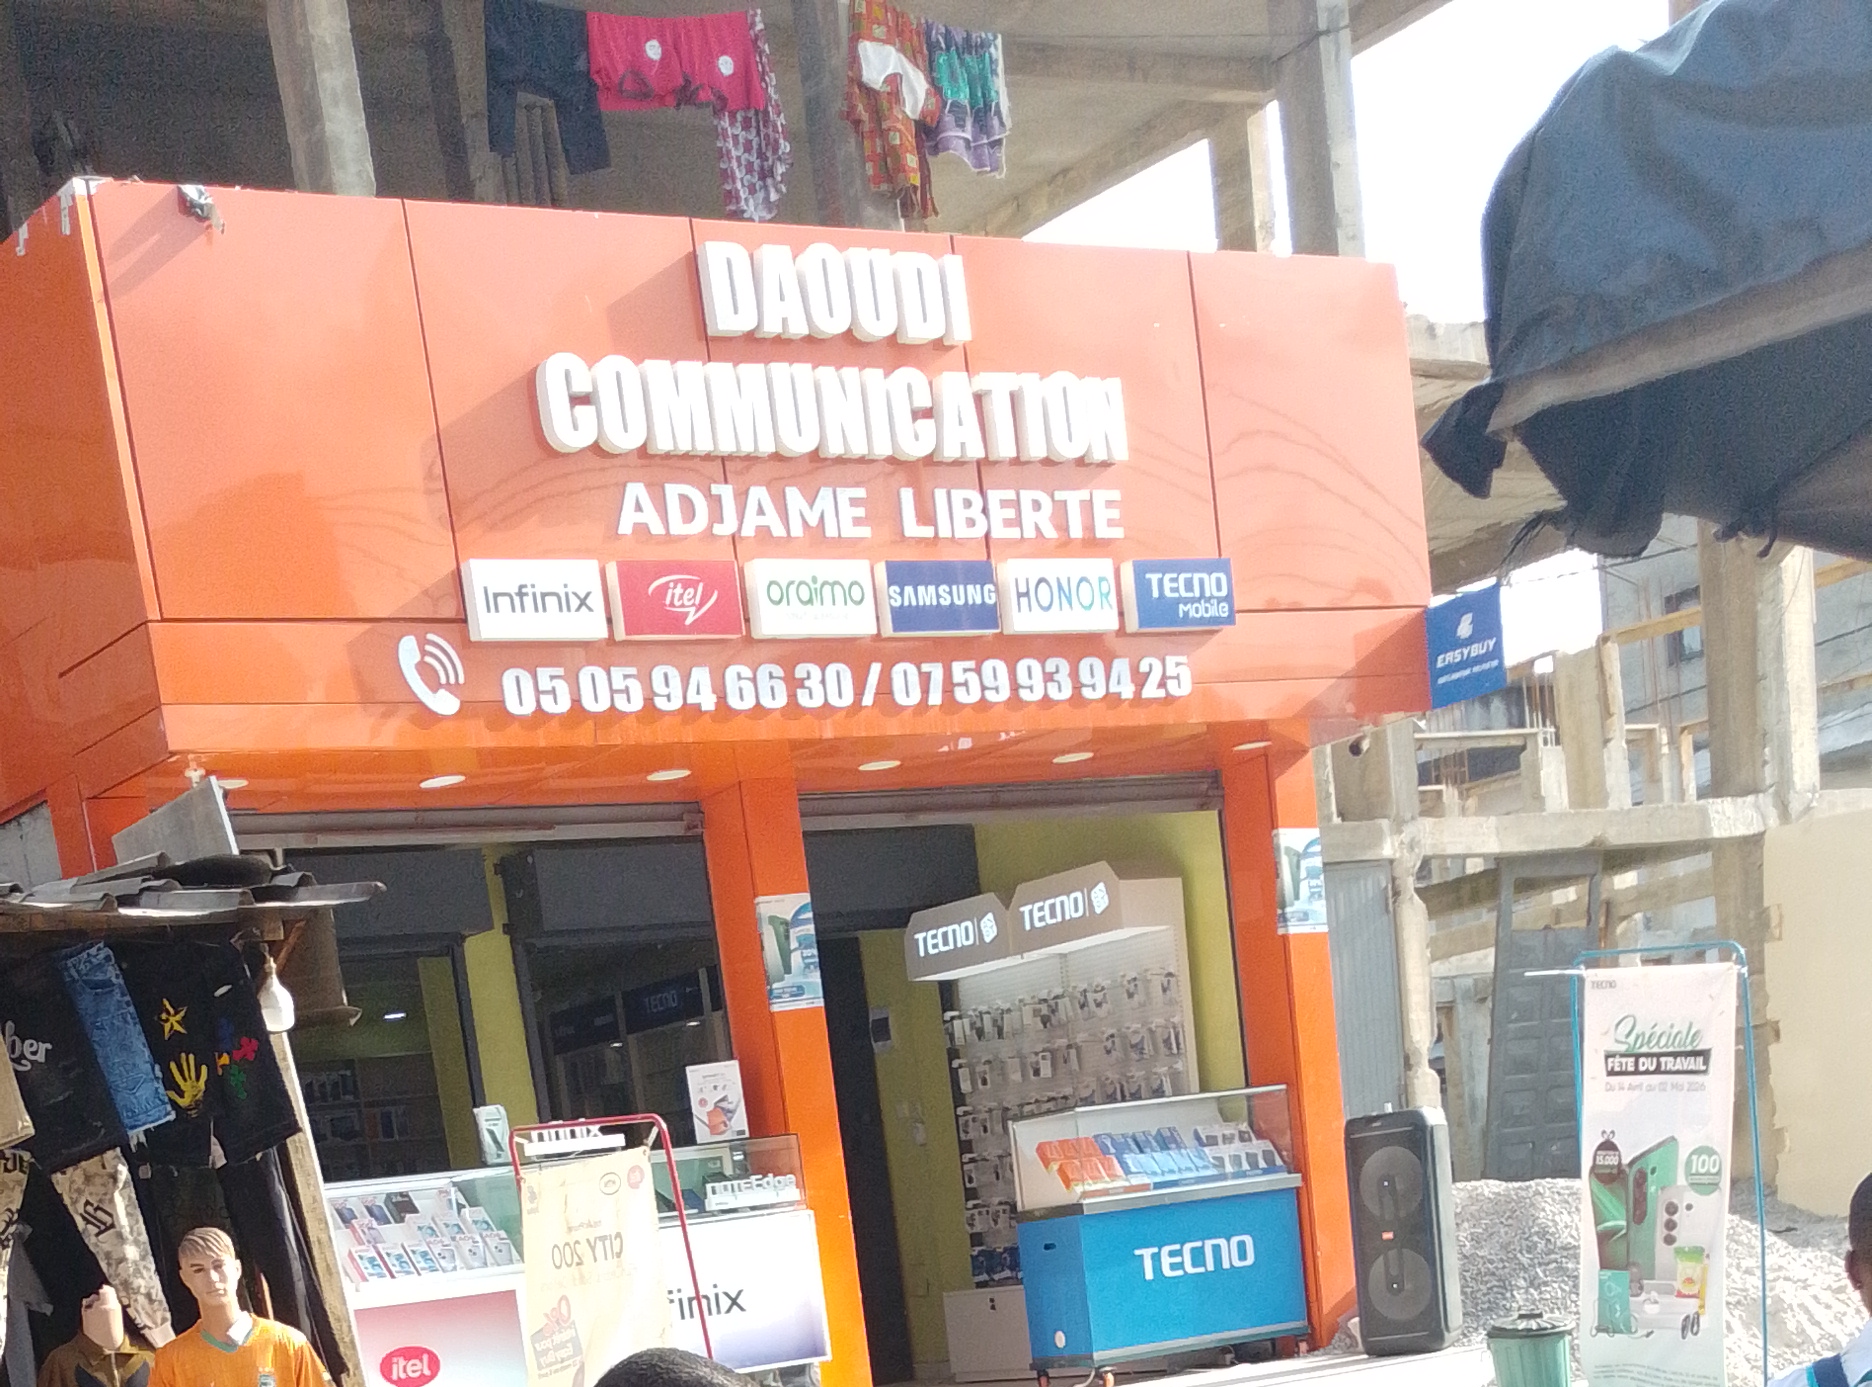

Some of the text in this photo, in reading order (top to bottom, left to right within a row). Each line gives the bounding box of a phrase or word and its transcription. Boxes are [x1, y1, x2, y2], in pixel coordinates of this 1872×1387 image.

[698, 241, 972, 345] DAOUDI
[536, 352, 1129, 462] COMMUNICATION
[617, 482, 1125, 540] ADJAME LIBERTE
[483, 583, 595, 614] Infinix
[665, 581, 704, 607] itel
[767, 574, 865, 607] oraimo
[889, 582, 996, 607] SAMSUNG
[1015, 576, 1113, 613] HONOR
[1145, 572, 1228, 598] TECNO
[1436, 637, 1496, 669] EASYBUY
[502, 668, 572, 716] 05
[578, 666, 645, 713] 05
[651, 664, 717, 712] 94
[724, 663, 788, 711] 66
[794, 662, 854, 709] 30
[1019, 891, 1084, 931] TECNO
[914, 920, 975, 957] TECNO
[1614, 1014, 1703, 1053] Spéciale
[1607, 1055, 1706, 1071] FÊTE DU TRAVAIL
[1691, 1154, 1719, 1174] 100
[1134, 1234, 1255, 1281] TECNO
[391, 1353, 431, 1380] itel
